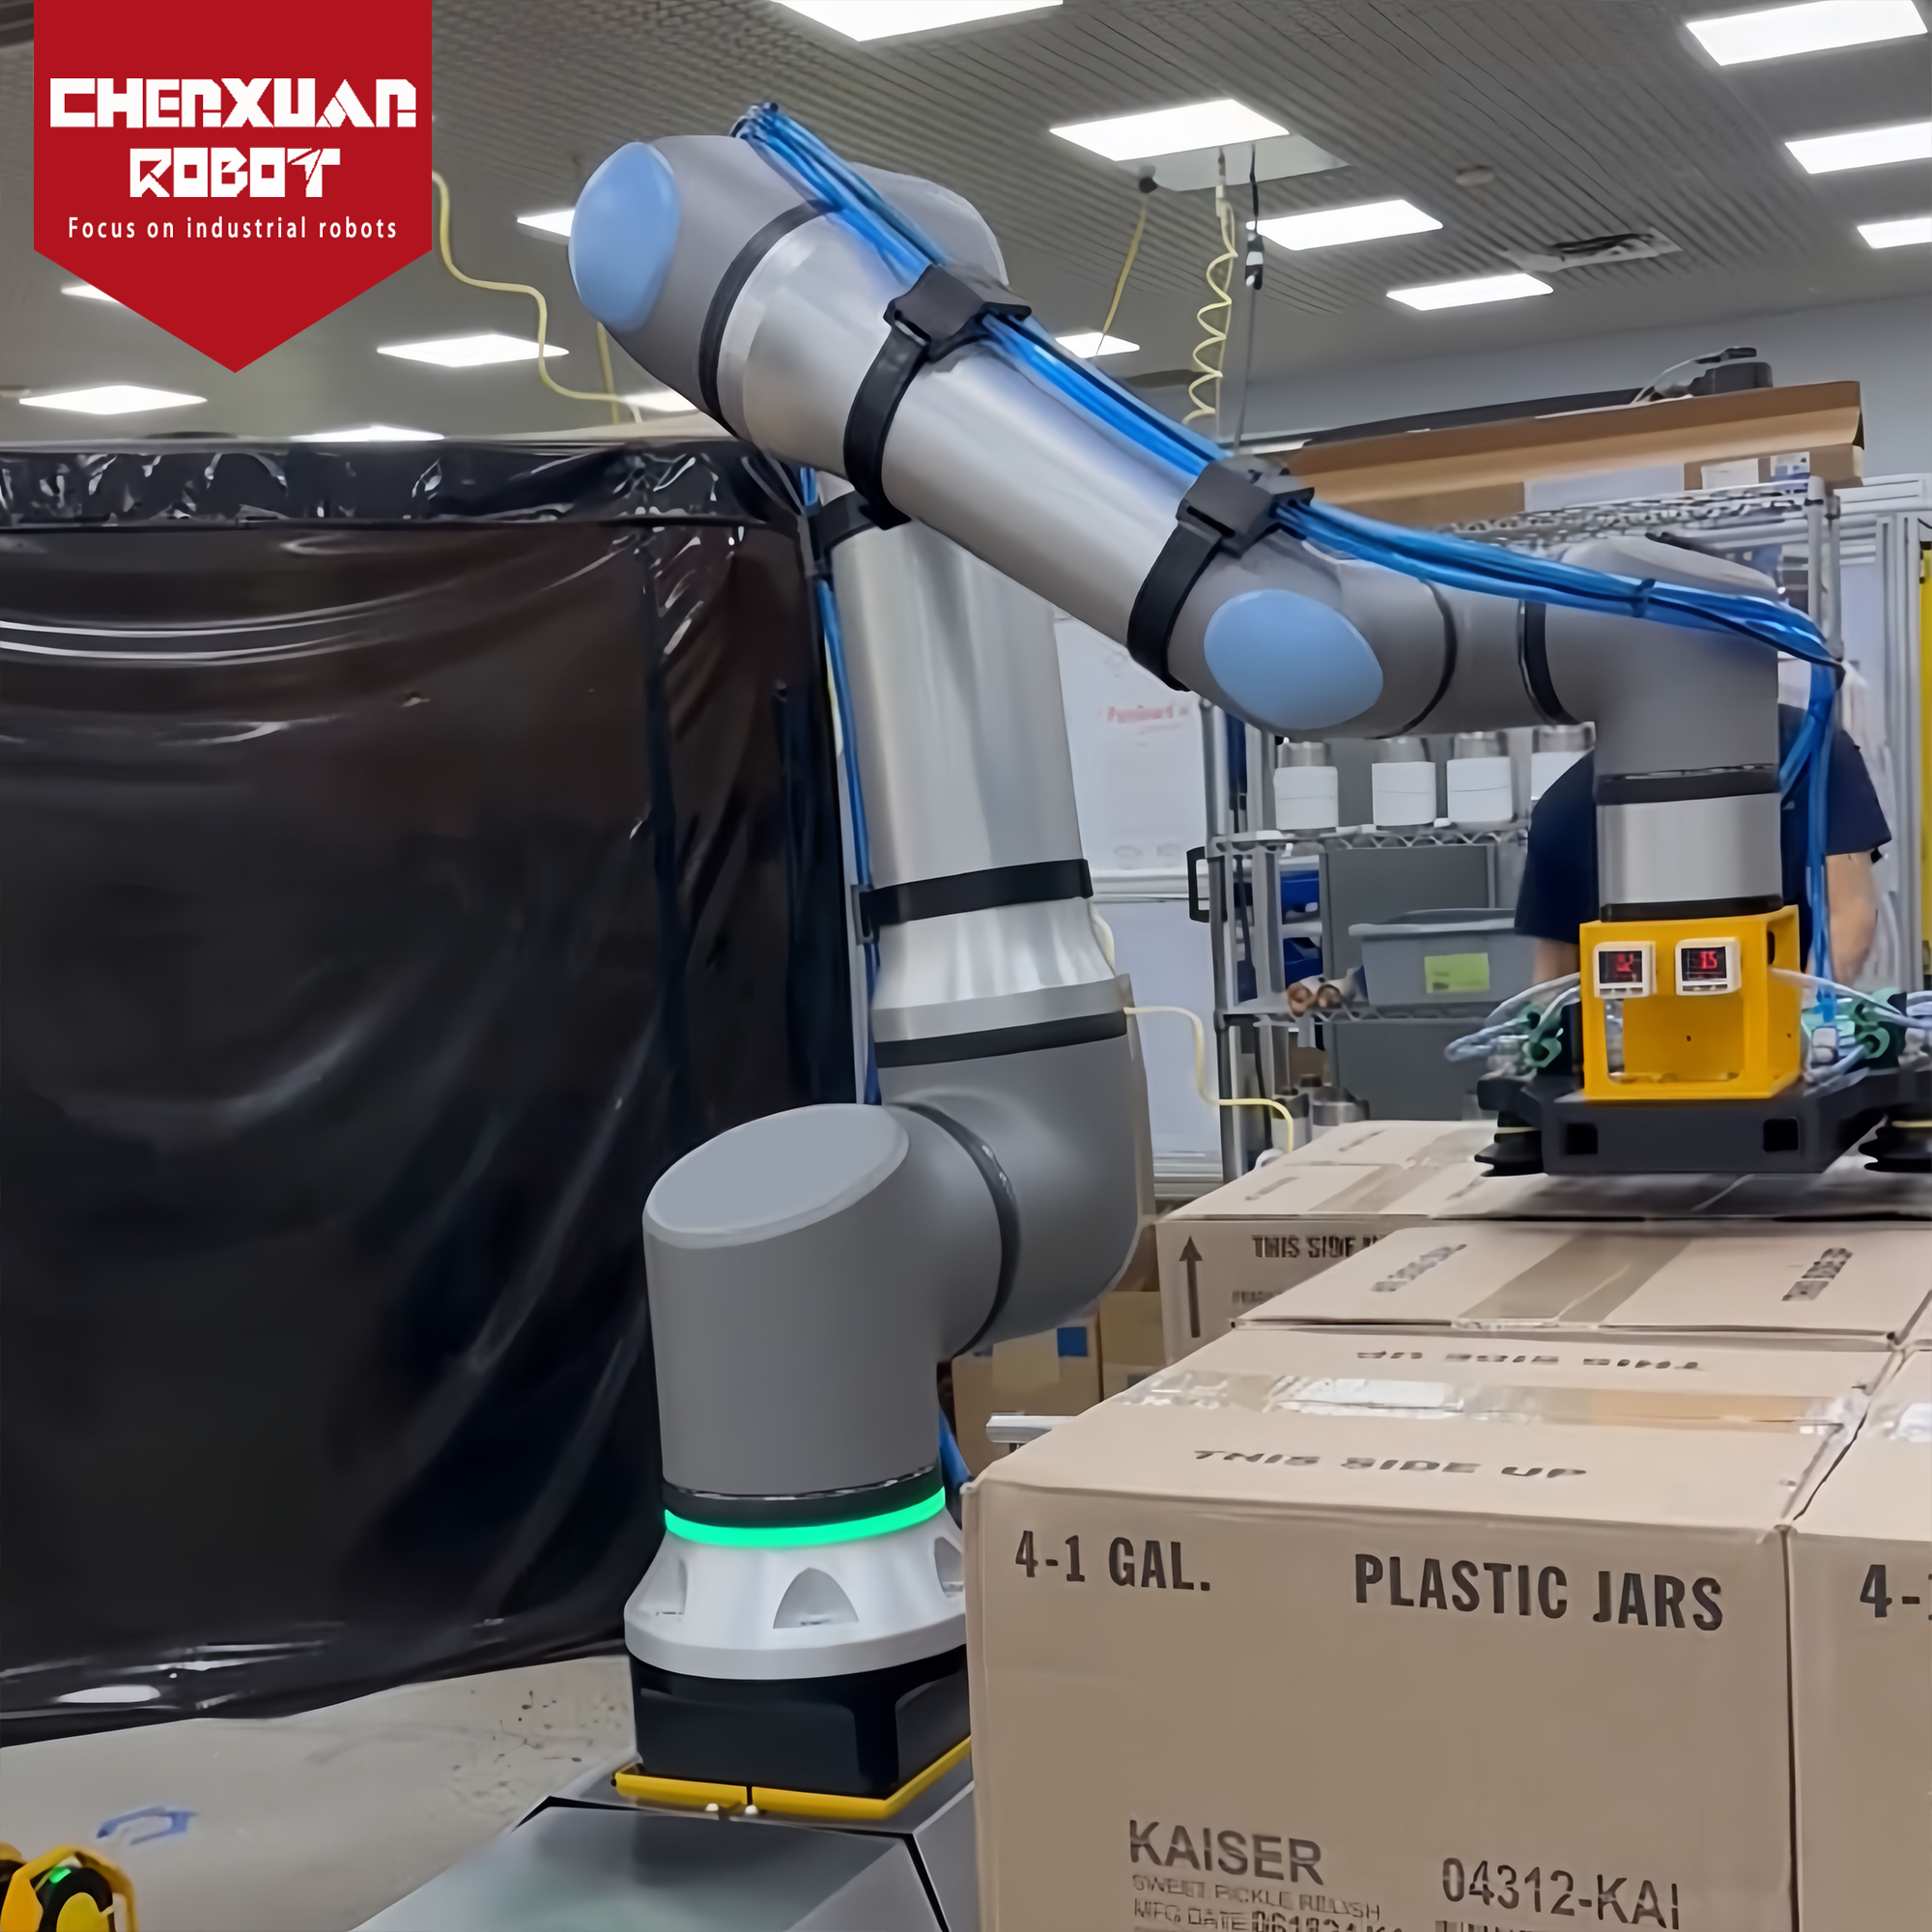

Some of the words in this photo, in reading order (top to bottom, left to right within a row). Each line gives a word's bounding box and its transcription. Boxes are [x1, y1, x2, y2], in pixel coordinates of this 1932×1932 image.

[1252, 1235, 1301, 1258] THIS
[1194, 1450, 1321, 1466] THIS
[1341, 1457, 1481, 1474] SIDE
[1501, 1466, 1587, 1479] UP
[1015, 1530, 1085, 1582] 4-1
[1108, 1536, 1210, 1591] GAL.
[1860, 1564, 1932, 1618] 4-
[1355, 1553, 1568, 1619] PLASTIC
[1593, 1571, 1723, 1631] JARS
[1129, 1819, 1324, 1886] KAISER
[1442, 1858, 1679, 1930] 04312-KAI
